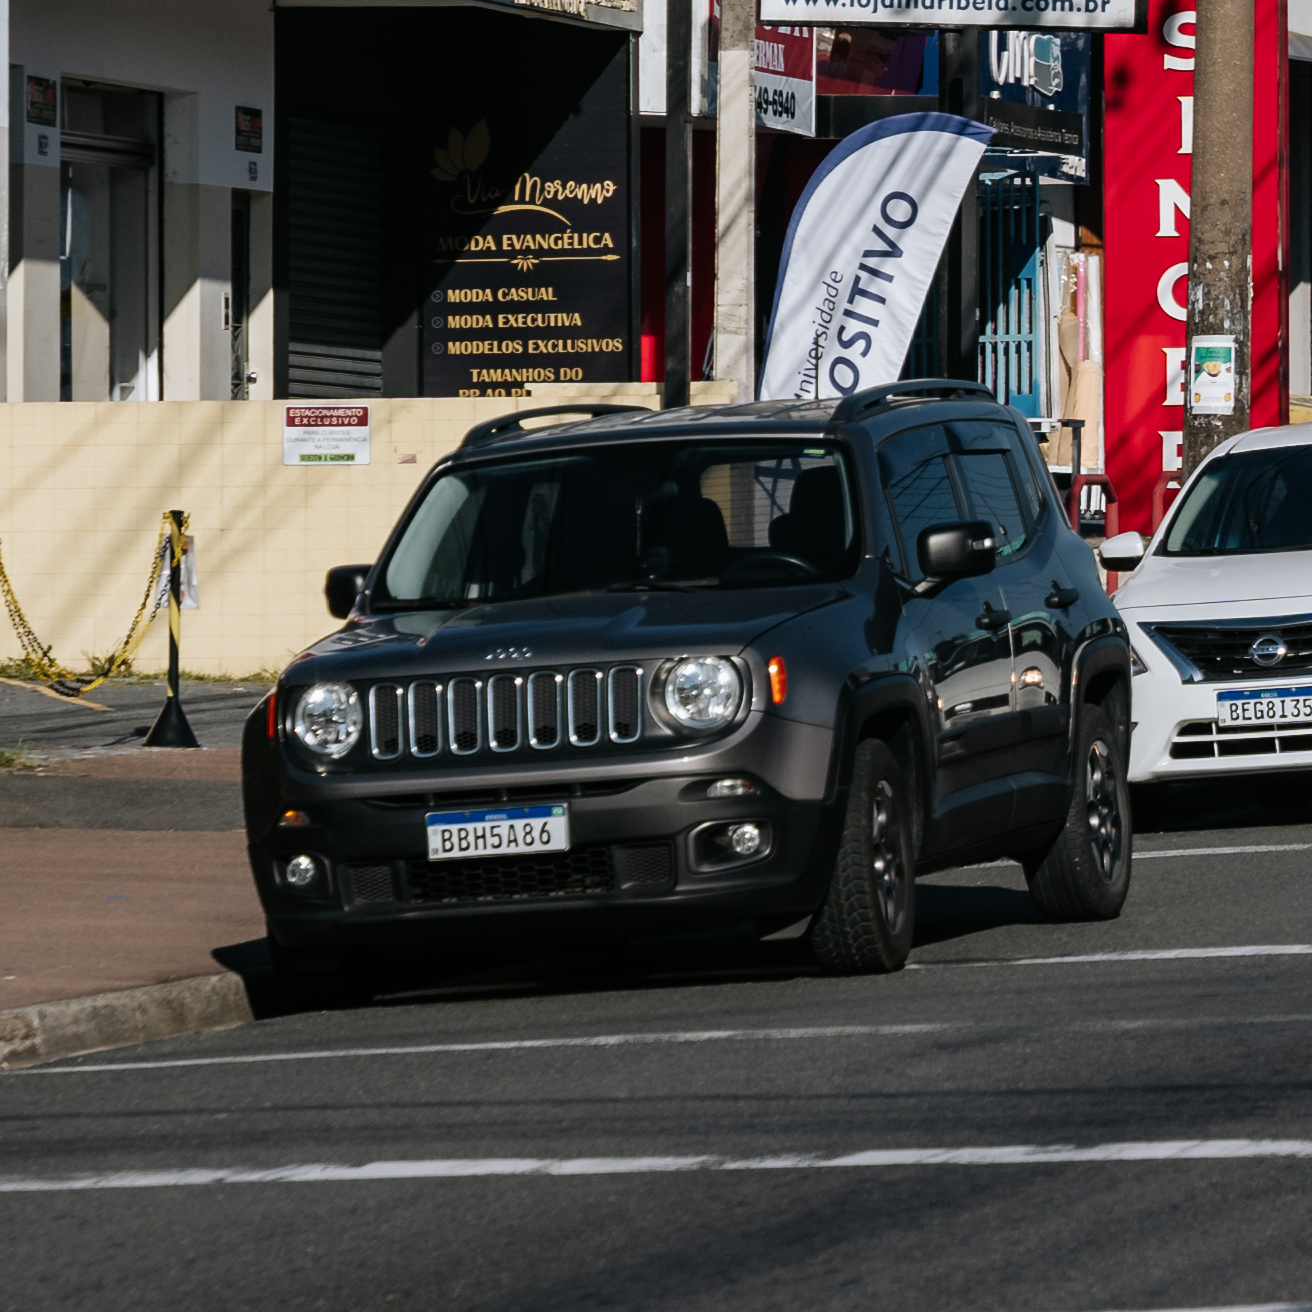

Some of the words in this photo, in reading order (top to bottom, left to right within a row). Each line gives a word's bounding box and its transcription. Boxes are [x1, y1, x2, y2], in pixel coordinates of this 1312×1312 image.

[514, 172, 618, 206] Morenno
[436, 234, 497, 252] MODA
[501, 229, 614, 251] EVANGÉLICA
[447, 288, 494, 303] MODA
[497, 286, 557, 302] CASUAL
[447, 315, 494, 329] MODA
[497, 312, 582, 328] EXECUTIVA
[447, 340, 524, 356] MODELOS
[527, 337, 624, 355] EXCLUSIVOS
[469, 367, 556, 383] TAMANHOS
[559, 367, 583, 381] DO
[288, 408, 365, 417] ESTACIONAMENTO
[294, 417, 359, 425] EXCLUSIVO
[1229, 698, 1312, 722] BEG8I35
[440, 821, 551, 853] BBH5A86
